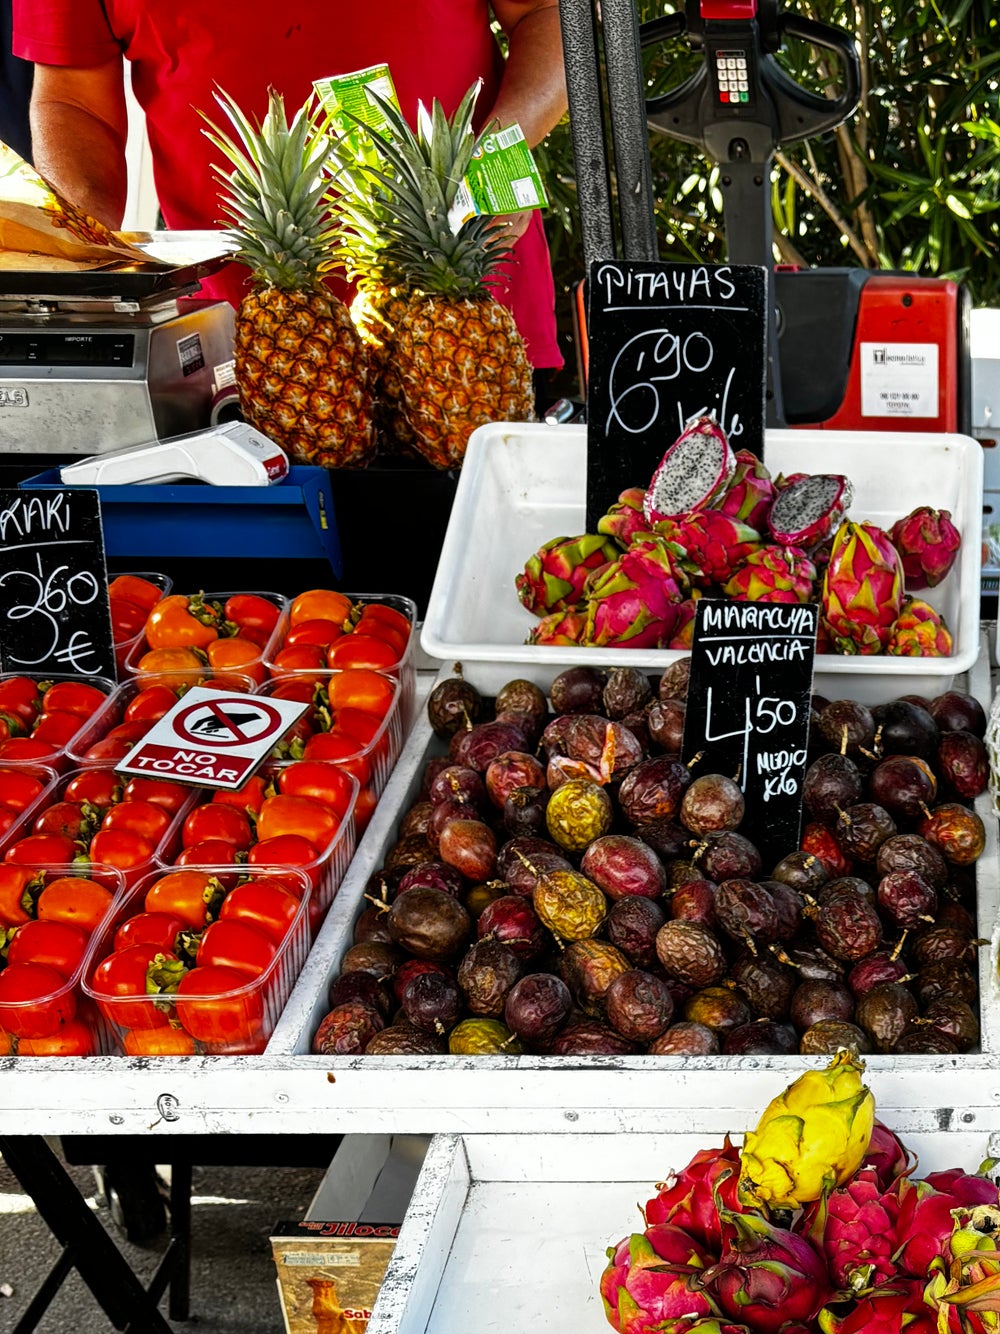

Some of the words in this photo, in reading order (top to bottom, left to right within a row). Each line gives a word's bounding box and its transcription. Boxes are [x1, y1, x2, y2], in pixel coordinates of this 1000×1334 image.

[597, 264, 736, 305] PITAYAS
[703, 604, 814, 635] MARACUYA
[137, 755, 240, 782] TOCAR
[172, 750, 218, 765] NO
